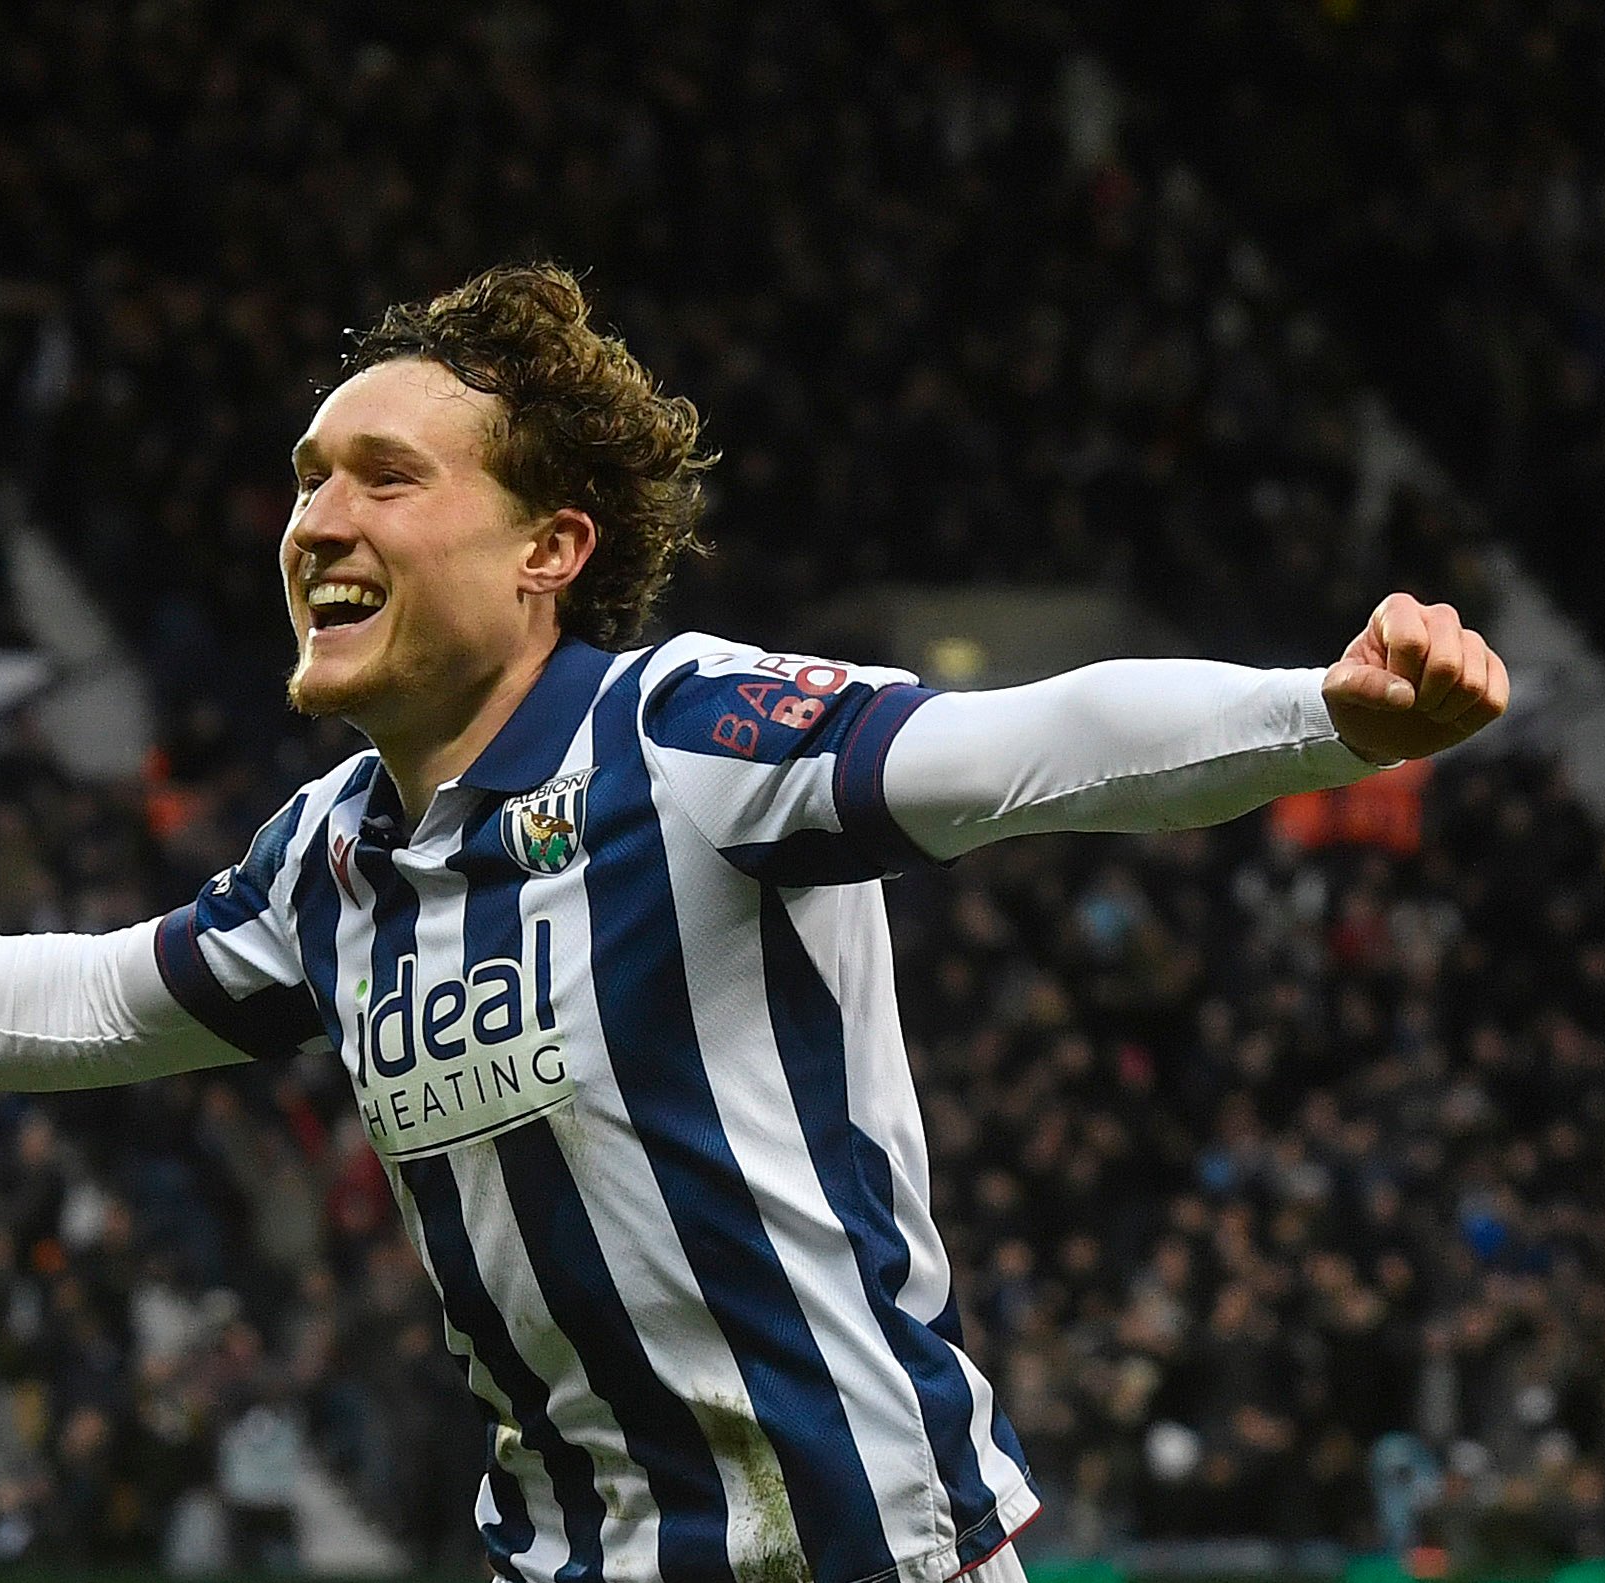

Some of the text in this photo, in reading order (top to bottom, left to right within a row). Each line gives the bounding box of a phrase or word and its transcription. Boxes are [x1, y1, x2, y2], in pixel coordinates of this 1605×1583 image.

[769, 657, 852, 730] BO
[509, 775, 586, 808] ALBION
[355, 918, 556, 1088] ideal
[363, 1045, 566, 1141] HEATING
